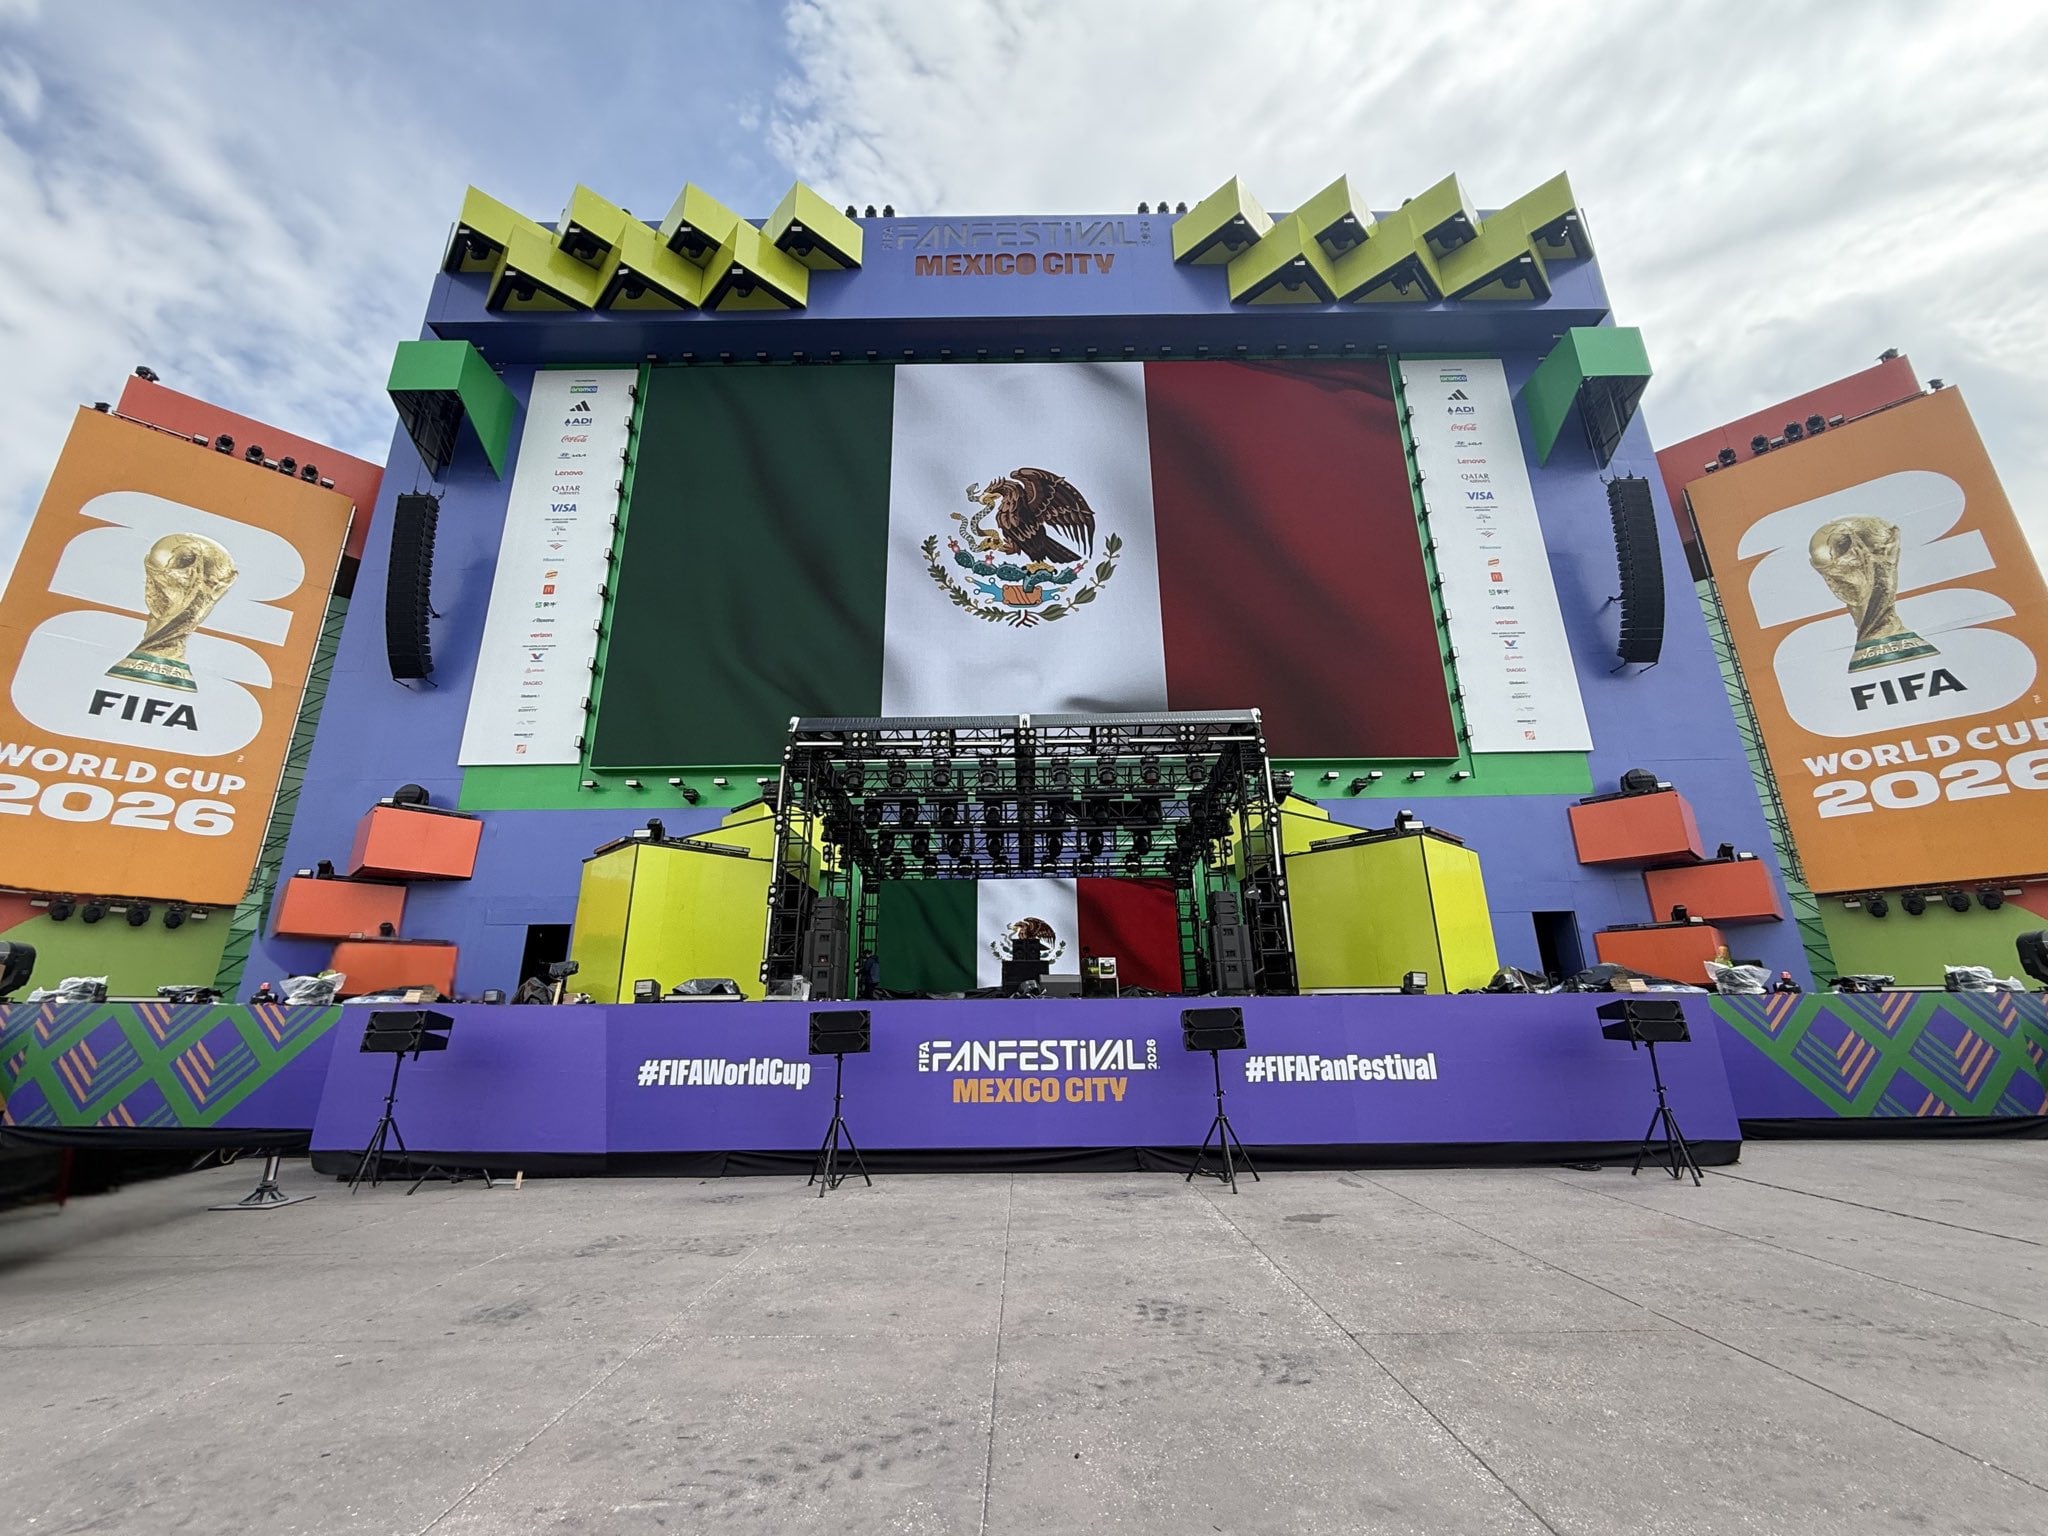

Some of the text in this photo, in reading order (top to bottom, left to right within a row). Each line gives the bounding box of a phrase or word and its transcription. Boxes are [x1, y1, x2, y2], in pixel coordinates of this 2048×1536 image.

[915, 252, 1115, 276] MEXICO CITY
[550, 503, 577, 512] VISA
[1464, 491, 1495, 500] VISA
[1850, 668, 1968, 711] FIFA
[88, 689, 199, 731] FIFA
[0, 741, 246, 795] WORLD CUP
[1802, 735, 1961, 777] WORLD
[918, 1041, 930, 1072] FIFA
[1147, 1039, 1157, 1070] 2026
[1245, 1052, 1438, 1082] #FIFAFanFestival
[637, 1058, 811, 1090] #FIFAWorldCup
[953, 1076, 1128, 1103] MEXICO CITY
